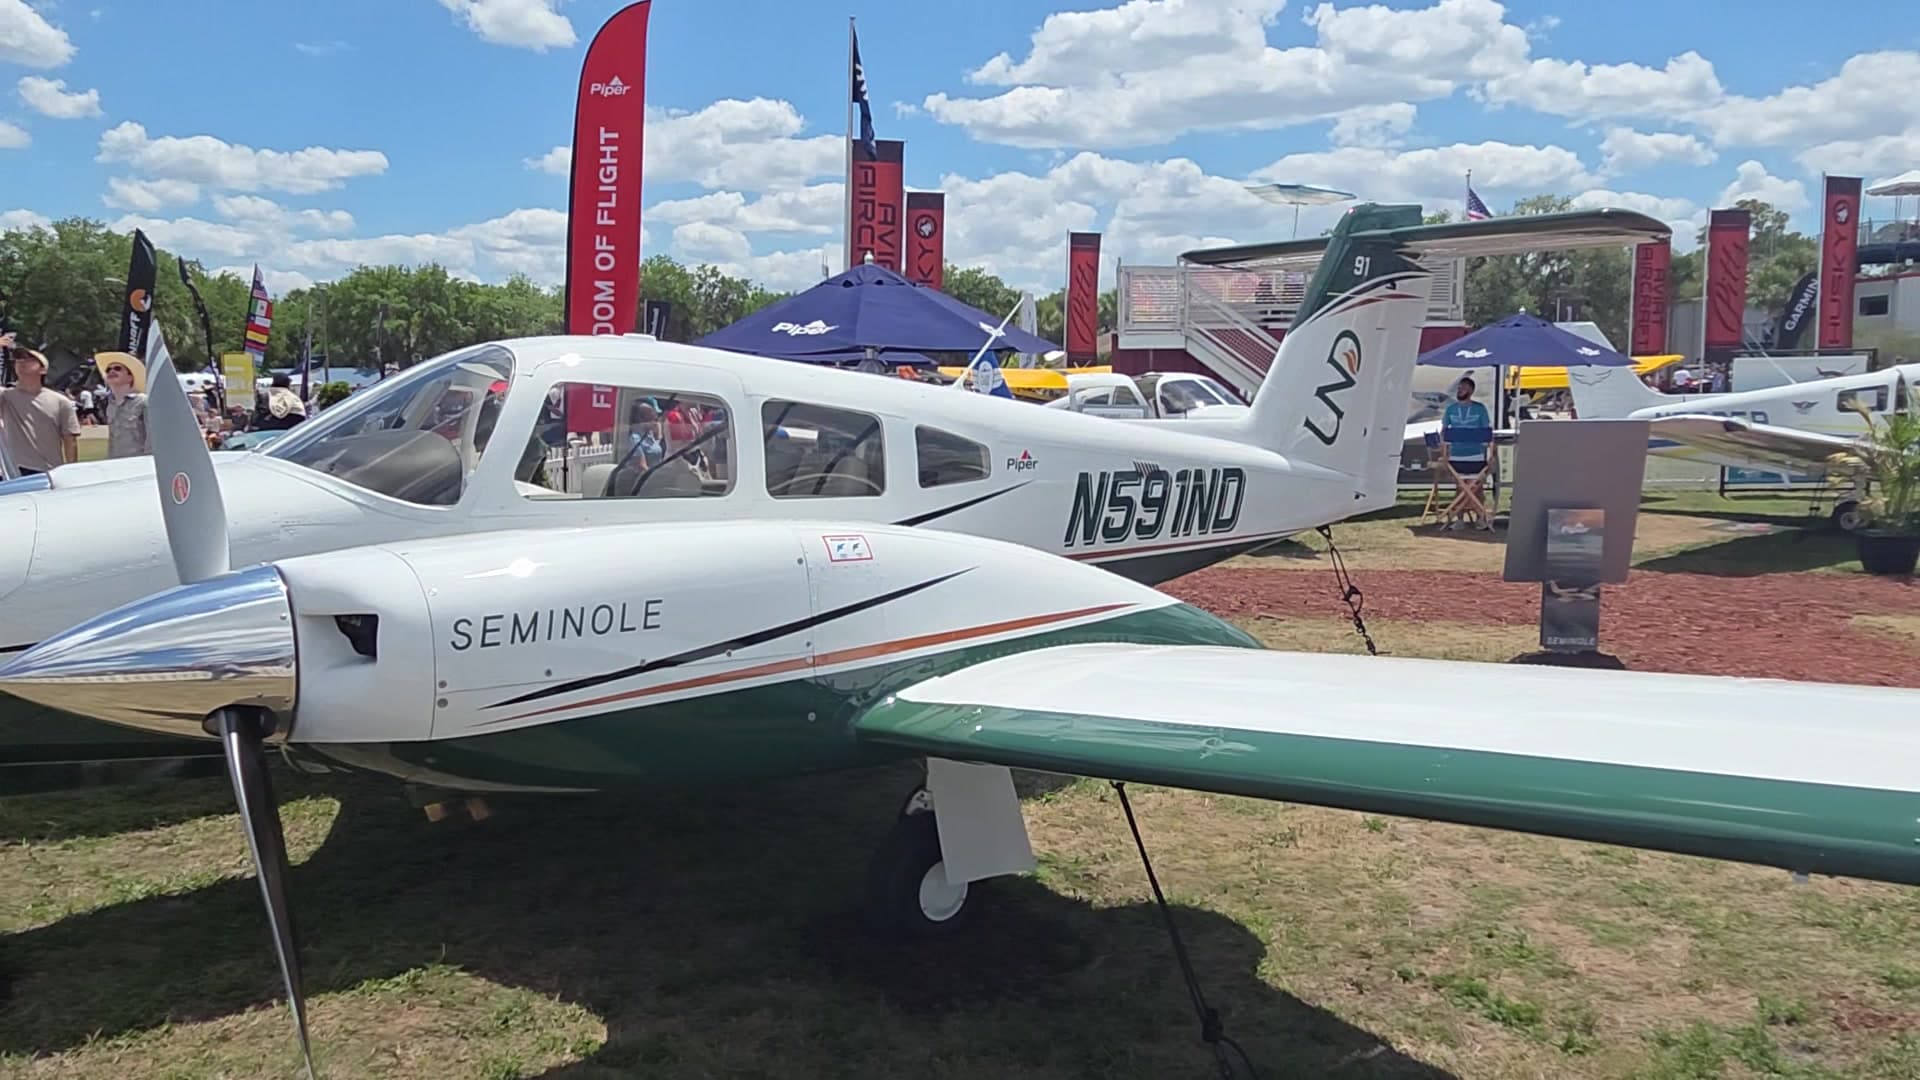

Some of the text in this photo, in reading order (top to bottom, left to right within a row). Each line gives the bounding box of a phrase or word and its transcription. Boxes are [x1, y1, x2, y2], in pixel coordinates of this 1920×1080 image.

[590, 80, 631, 98] Piper
[596, 126, 619, 225] FLIGHT
[595, 235, 616, 272] OF
[1353, 256, 1371, 276] 91
[1637, 247, 1654, 348] AIRCRAFT
[1784, 277, 1818, 330] GARMIN
[1827, 229, 1848, 344] HUSKY
[771, 320, 839, 336] Piper
[1006, 456, 1039, 472] Piper
[1063, 467, 1247, 548] N591ND
[450, 599, 664, 651] SEMINOLE
